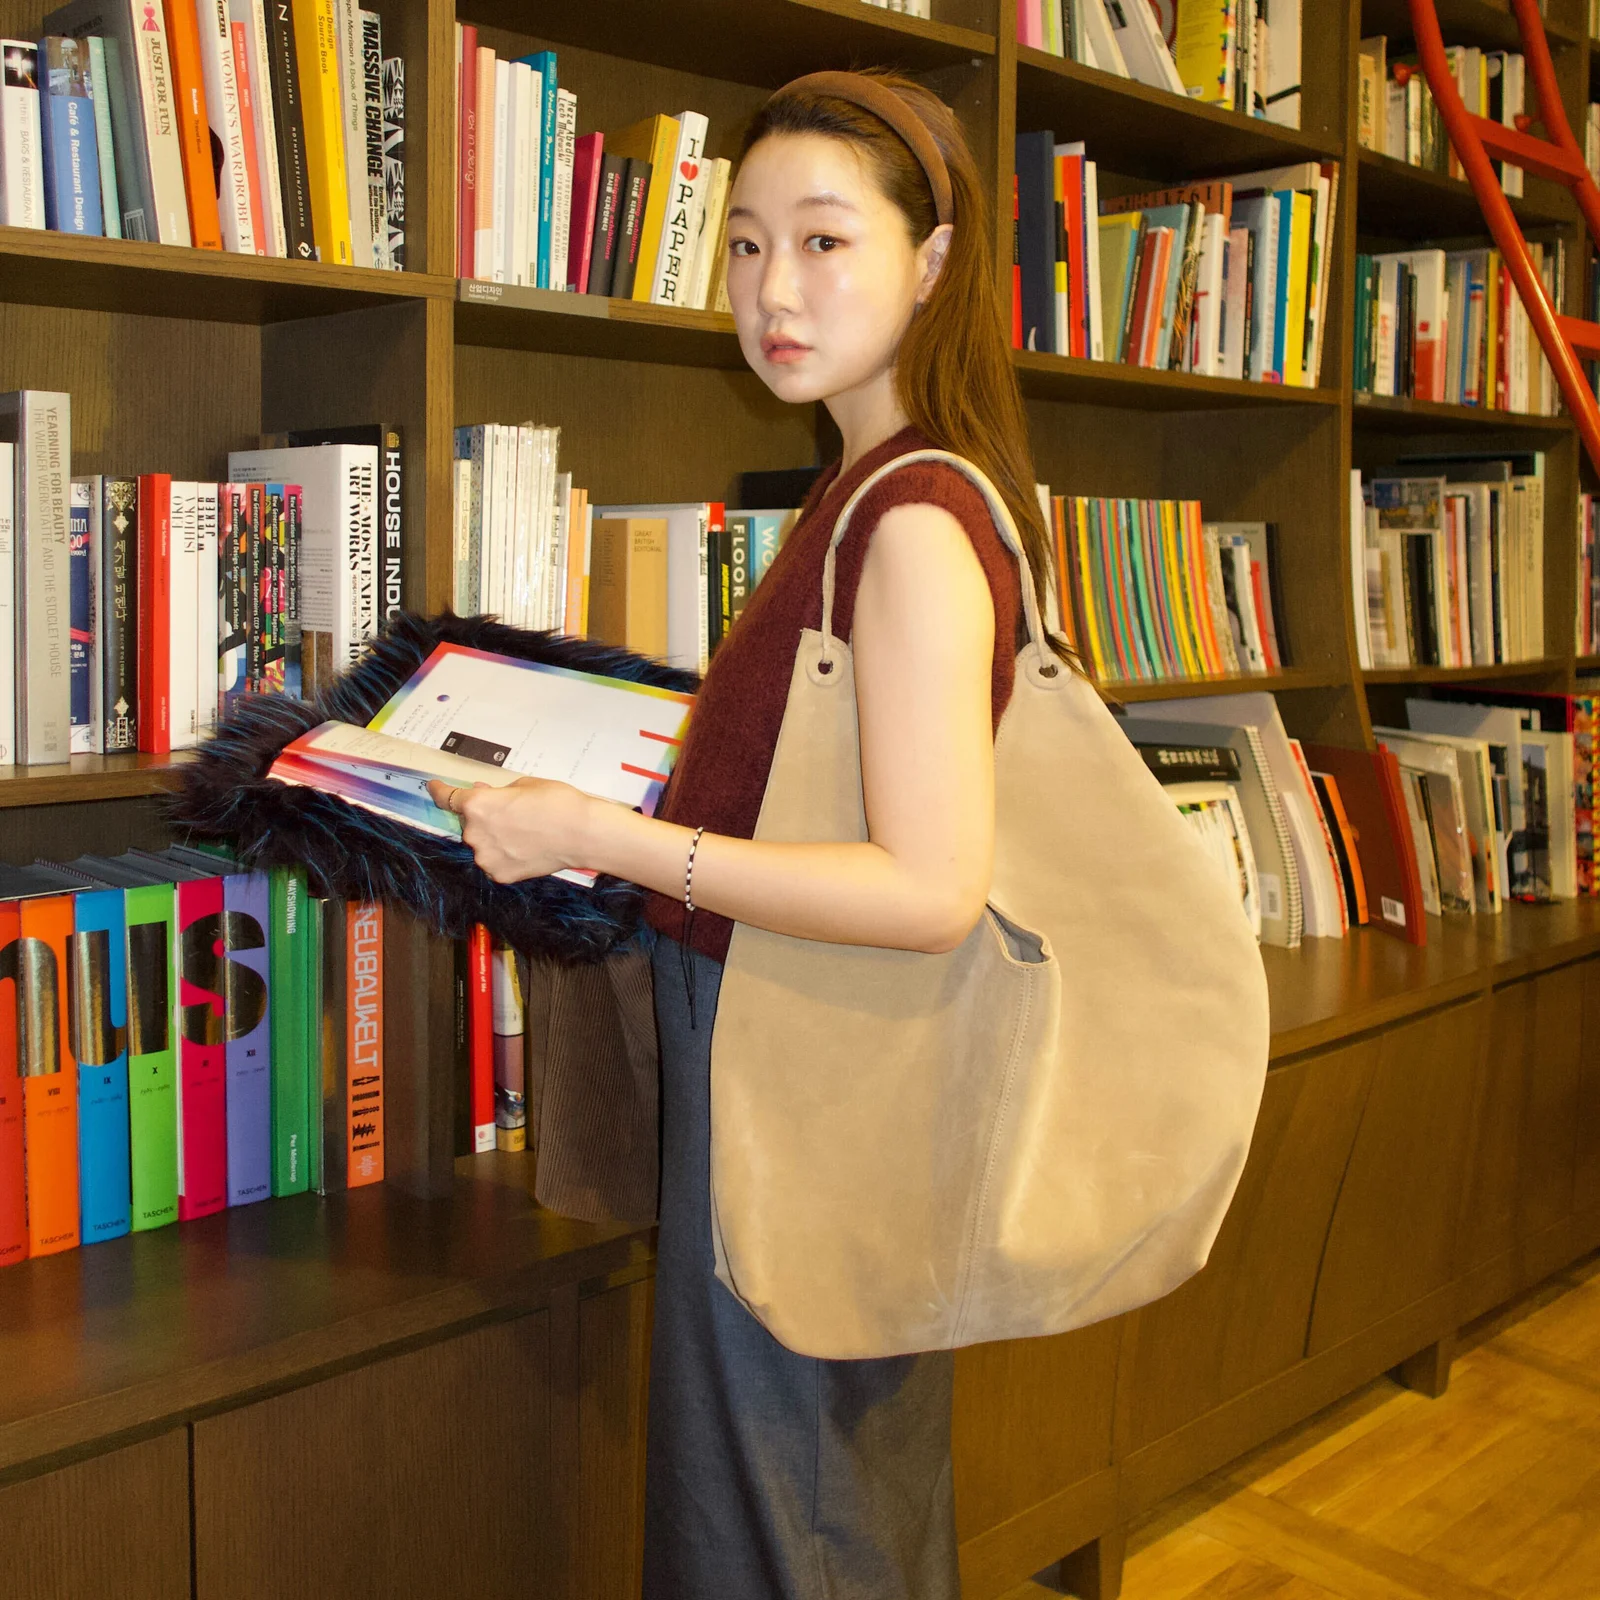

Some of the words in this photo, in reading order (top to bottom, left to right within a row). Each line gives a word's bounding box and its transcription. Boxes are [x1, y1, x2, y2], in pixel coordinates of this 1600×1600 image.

[318, 15, 327, 48] Source
[326, 17, 335, 49] Design
[347, 19, 355, 57] Morrison
[152, 37, 164, 73] JUST
[320, 50, 328, 75] Book
[361, 19, 382, 103] MASSIVE
[155, 76, 168, 104] FOR
[349, 68, 357, 91] Book
[351, 92, 358, 101] of
[68, 101, 80, 125] Café
[158, 107, 171, 136] FUN
[351, 103, 359, 131] Things
[468, 108, 476, 130] sex
[557, 98, 566, 118] Lech
[566, 100, 576, 125] Reza
[20, 130, 30, 154] BARS
[70, 128, 81, 136] &
[220, 49, 238, 128] WOMEN'S
[230, 135, 249, 227] WARDROBE
[365, 106, 384, 178] CHANGE
[467, 133, 475, 145] in
[557, 122, 567, 162] Majewski
[565, 129, 575, 168] Abedini
[688, 138, 700, 159] I
[21, 156, 30, 164] &
[71, 140, 83, 194] Restaurant
[465, 148, 476, 190] design
[610, 172, 621, 212] designing
[635, 177, 647, 217] designing
[73, 197, 85, 231] Design
[604, 215, 616, 260] exhibitions
[628, 219, 640, 264] exhibitions
[659, 183, 694, 302] PAPER
[469, 284, 503, 296] 산업디자인
[33, 408, 45, 426] THE
[35, 430, 48, 471] WIENER
[46, 407, 61, 468] YEARNING
[51, 472, 63, 495] FOR
[349, 462, 360, 503] ART
[361, 461, 372, 503] THE
[385, 451, 402, 548] HOUSE
[53, 498, 65, 544] BEAUTY
[171, 496, 184, 528] EIKO
[205, 497, 216, 537] JEKER
[349, 504, 360, 571] WORKS
[361, 514, 372, 566] MOST
[762, 526, 775, 567] WO
[42, 547, 55, 571] AND
[114, 540, 127, 578] 세기말
[733, 524, 745, 598] FLOOR
[45, 574, 57, 592] THE
[385, 557, 402, 621] INDU
[46, 596, 60, 640] STOCLET
[115, 583, 128, 622] 비엔나
[360, 570, 372, 648] EXPENS
[50, 643, 62, 679] HOUSE
[286, 878, 297, 934] WAYSHOWING
[354, 907, 378, 1067] NEUBAUWELT
[237, 1184, 267, 1196] TASCHEN
[94, 1218, 126, 1232] TASCHEN
[143, 1206, 174, 1219] TASCHEN
[41, 1232, 74, 1245] TASCHEN
